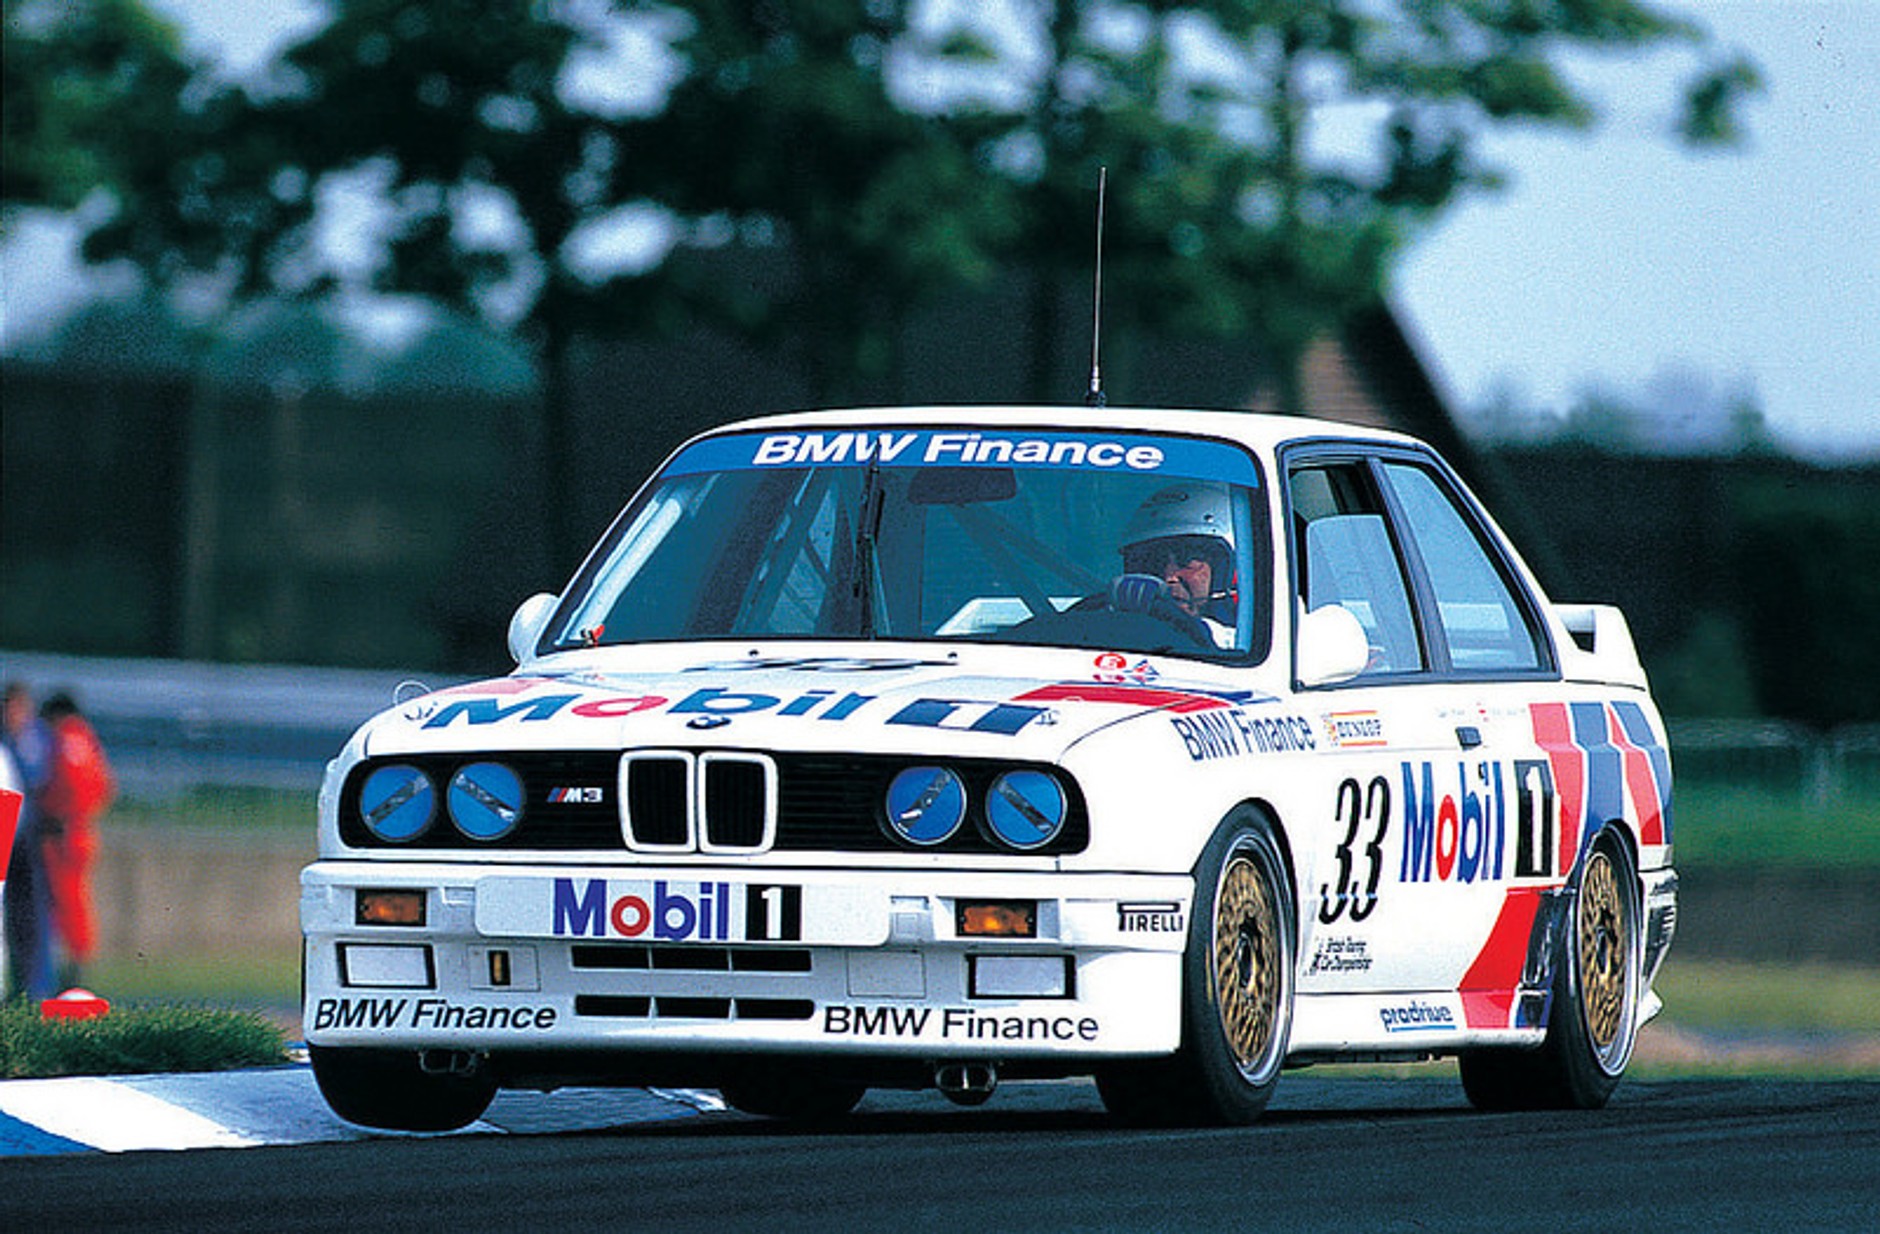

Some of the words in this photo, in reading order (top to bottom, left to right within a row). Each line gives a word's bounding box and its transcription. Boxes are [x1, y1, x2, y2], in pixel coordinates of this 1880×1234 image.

[752, 433, 919, 465] BMW
[923, 433, 1165, 470] Finance
[421, 687, 878, 730] Mobil
[1170, 710, 1240, 761] BMW
[1229, 709, 1317, 752] Finance
[563, 787, 603, 803] M3
[1399, 760, 1506, 884] Mobil
[1318, 775, 1391, 925] 33
[552, 877, 729, 942] Mobil
[1117, 901, 1184, 932] PIRELLI
[314, 998, 407, 1031] BMW
[410, 998, 557, 1030] Finance
[823, 1006, 932, 1036] BMW
[942, 1007, 1099, 1041] Finance
[1380, 1000, 1454, 1032] prodrive
